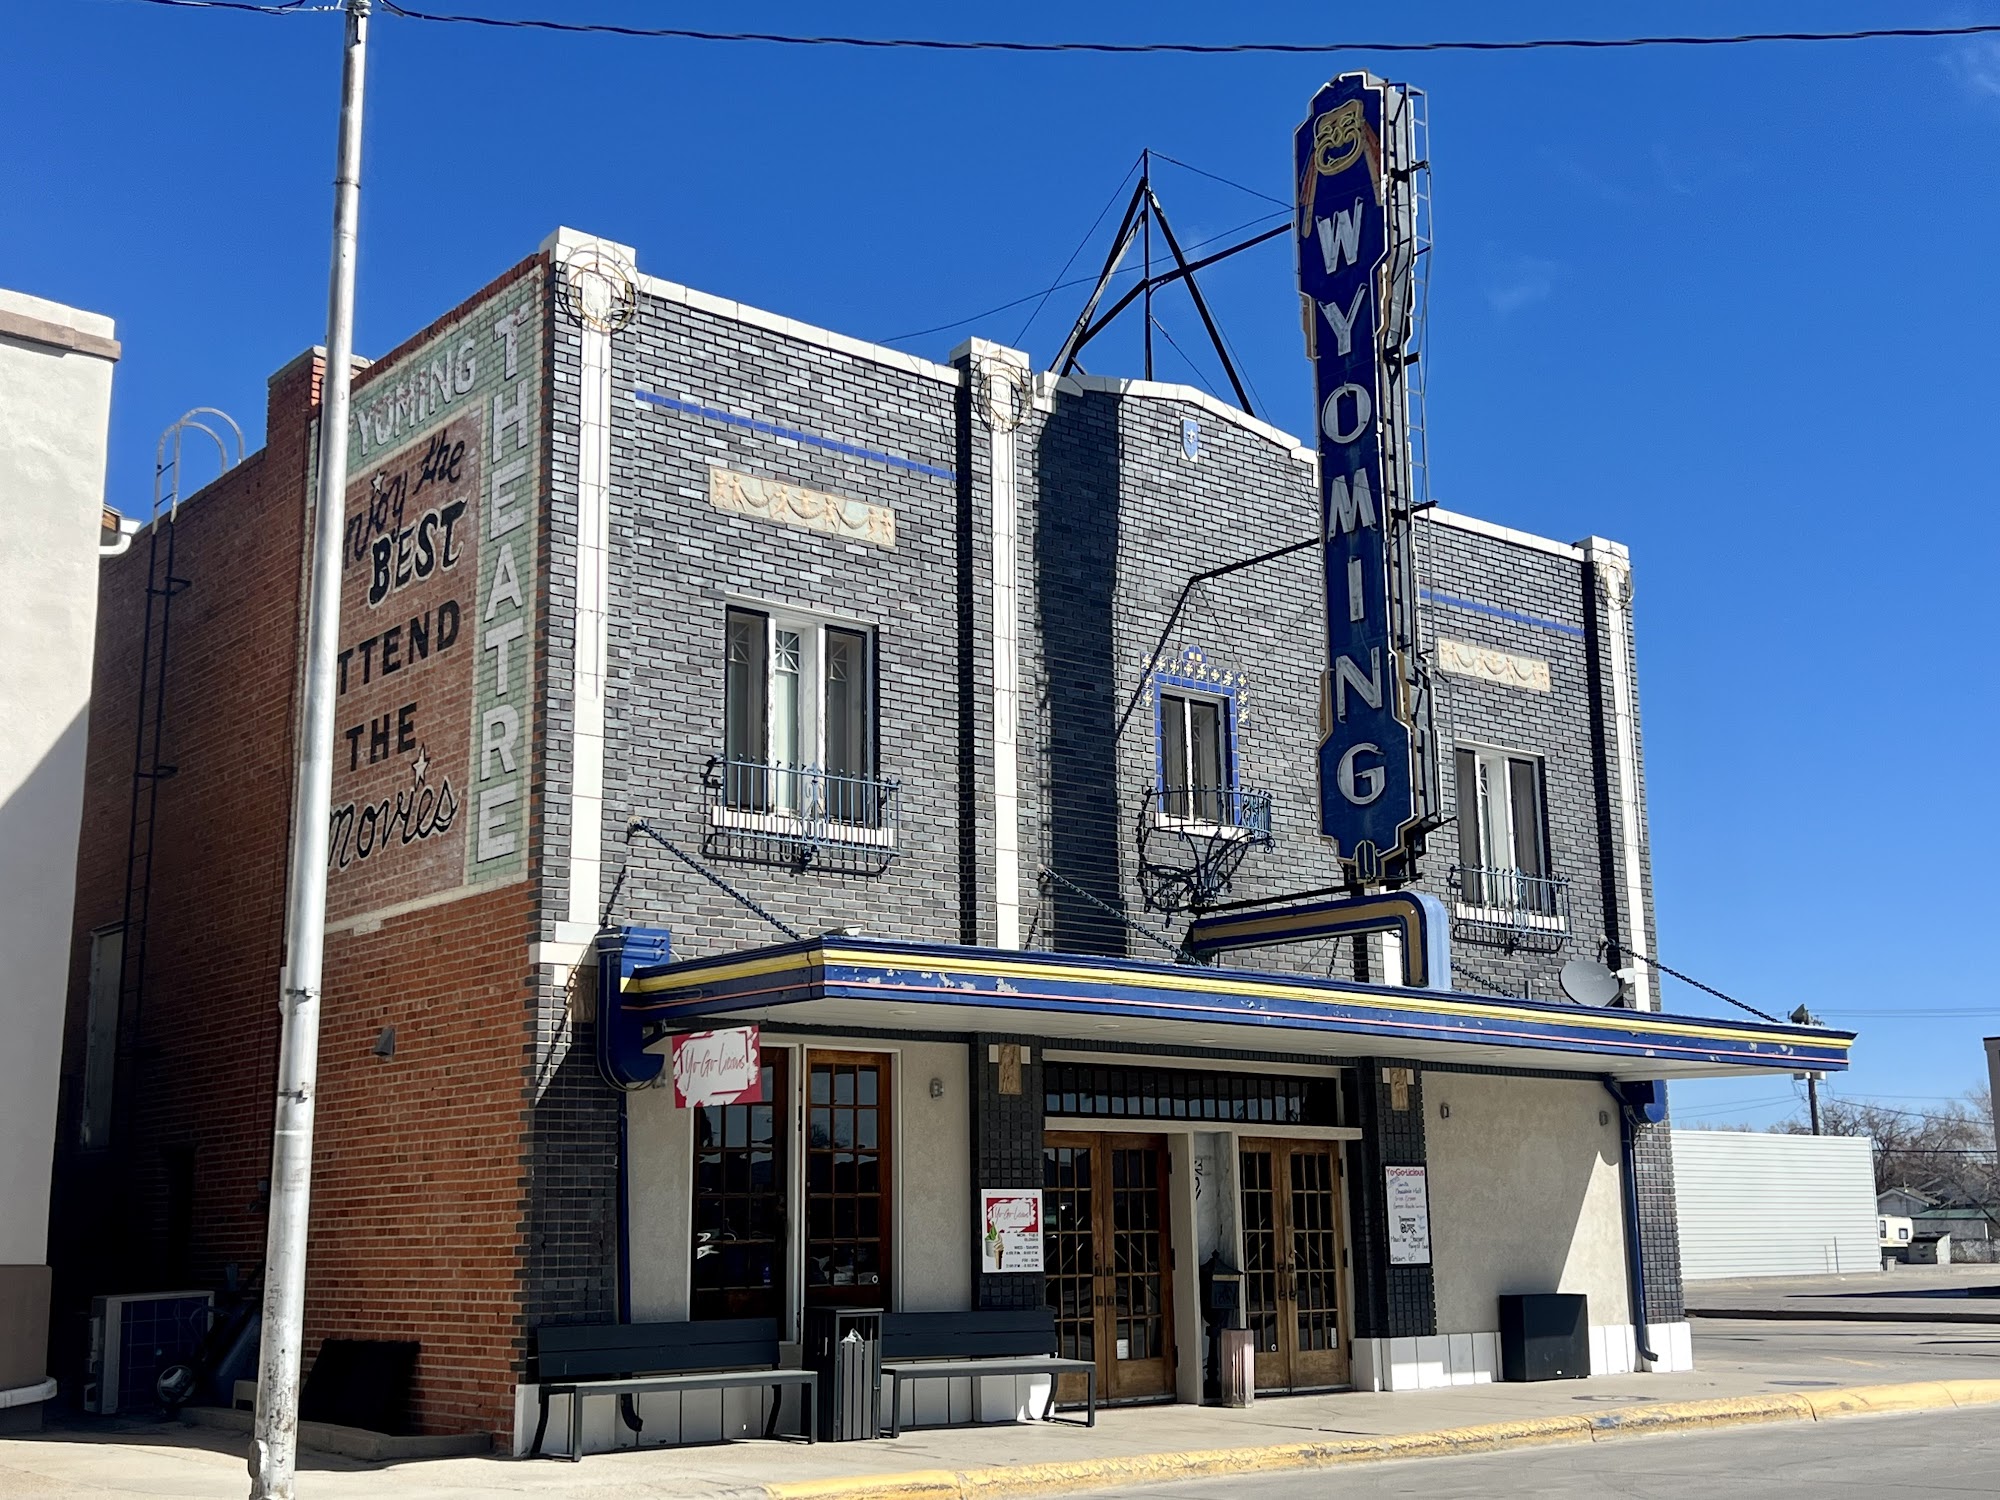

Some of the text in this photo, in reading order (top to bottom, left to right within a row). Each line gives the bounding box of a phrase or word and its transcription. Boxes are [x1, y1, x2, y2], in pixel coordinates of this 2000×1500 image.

[350, 338, 476, 457] YOMING
[344, 429, 466, 570] njoy the
[368, 491, 471, 609] BEST
[1315, 197, 1386, 805] WYOMING
[477, 302, 530, 863] THEATRE
[337, 600, 461, 696] TTEND
[346, 702, 417, 772] THE
